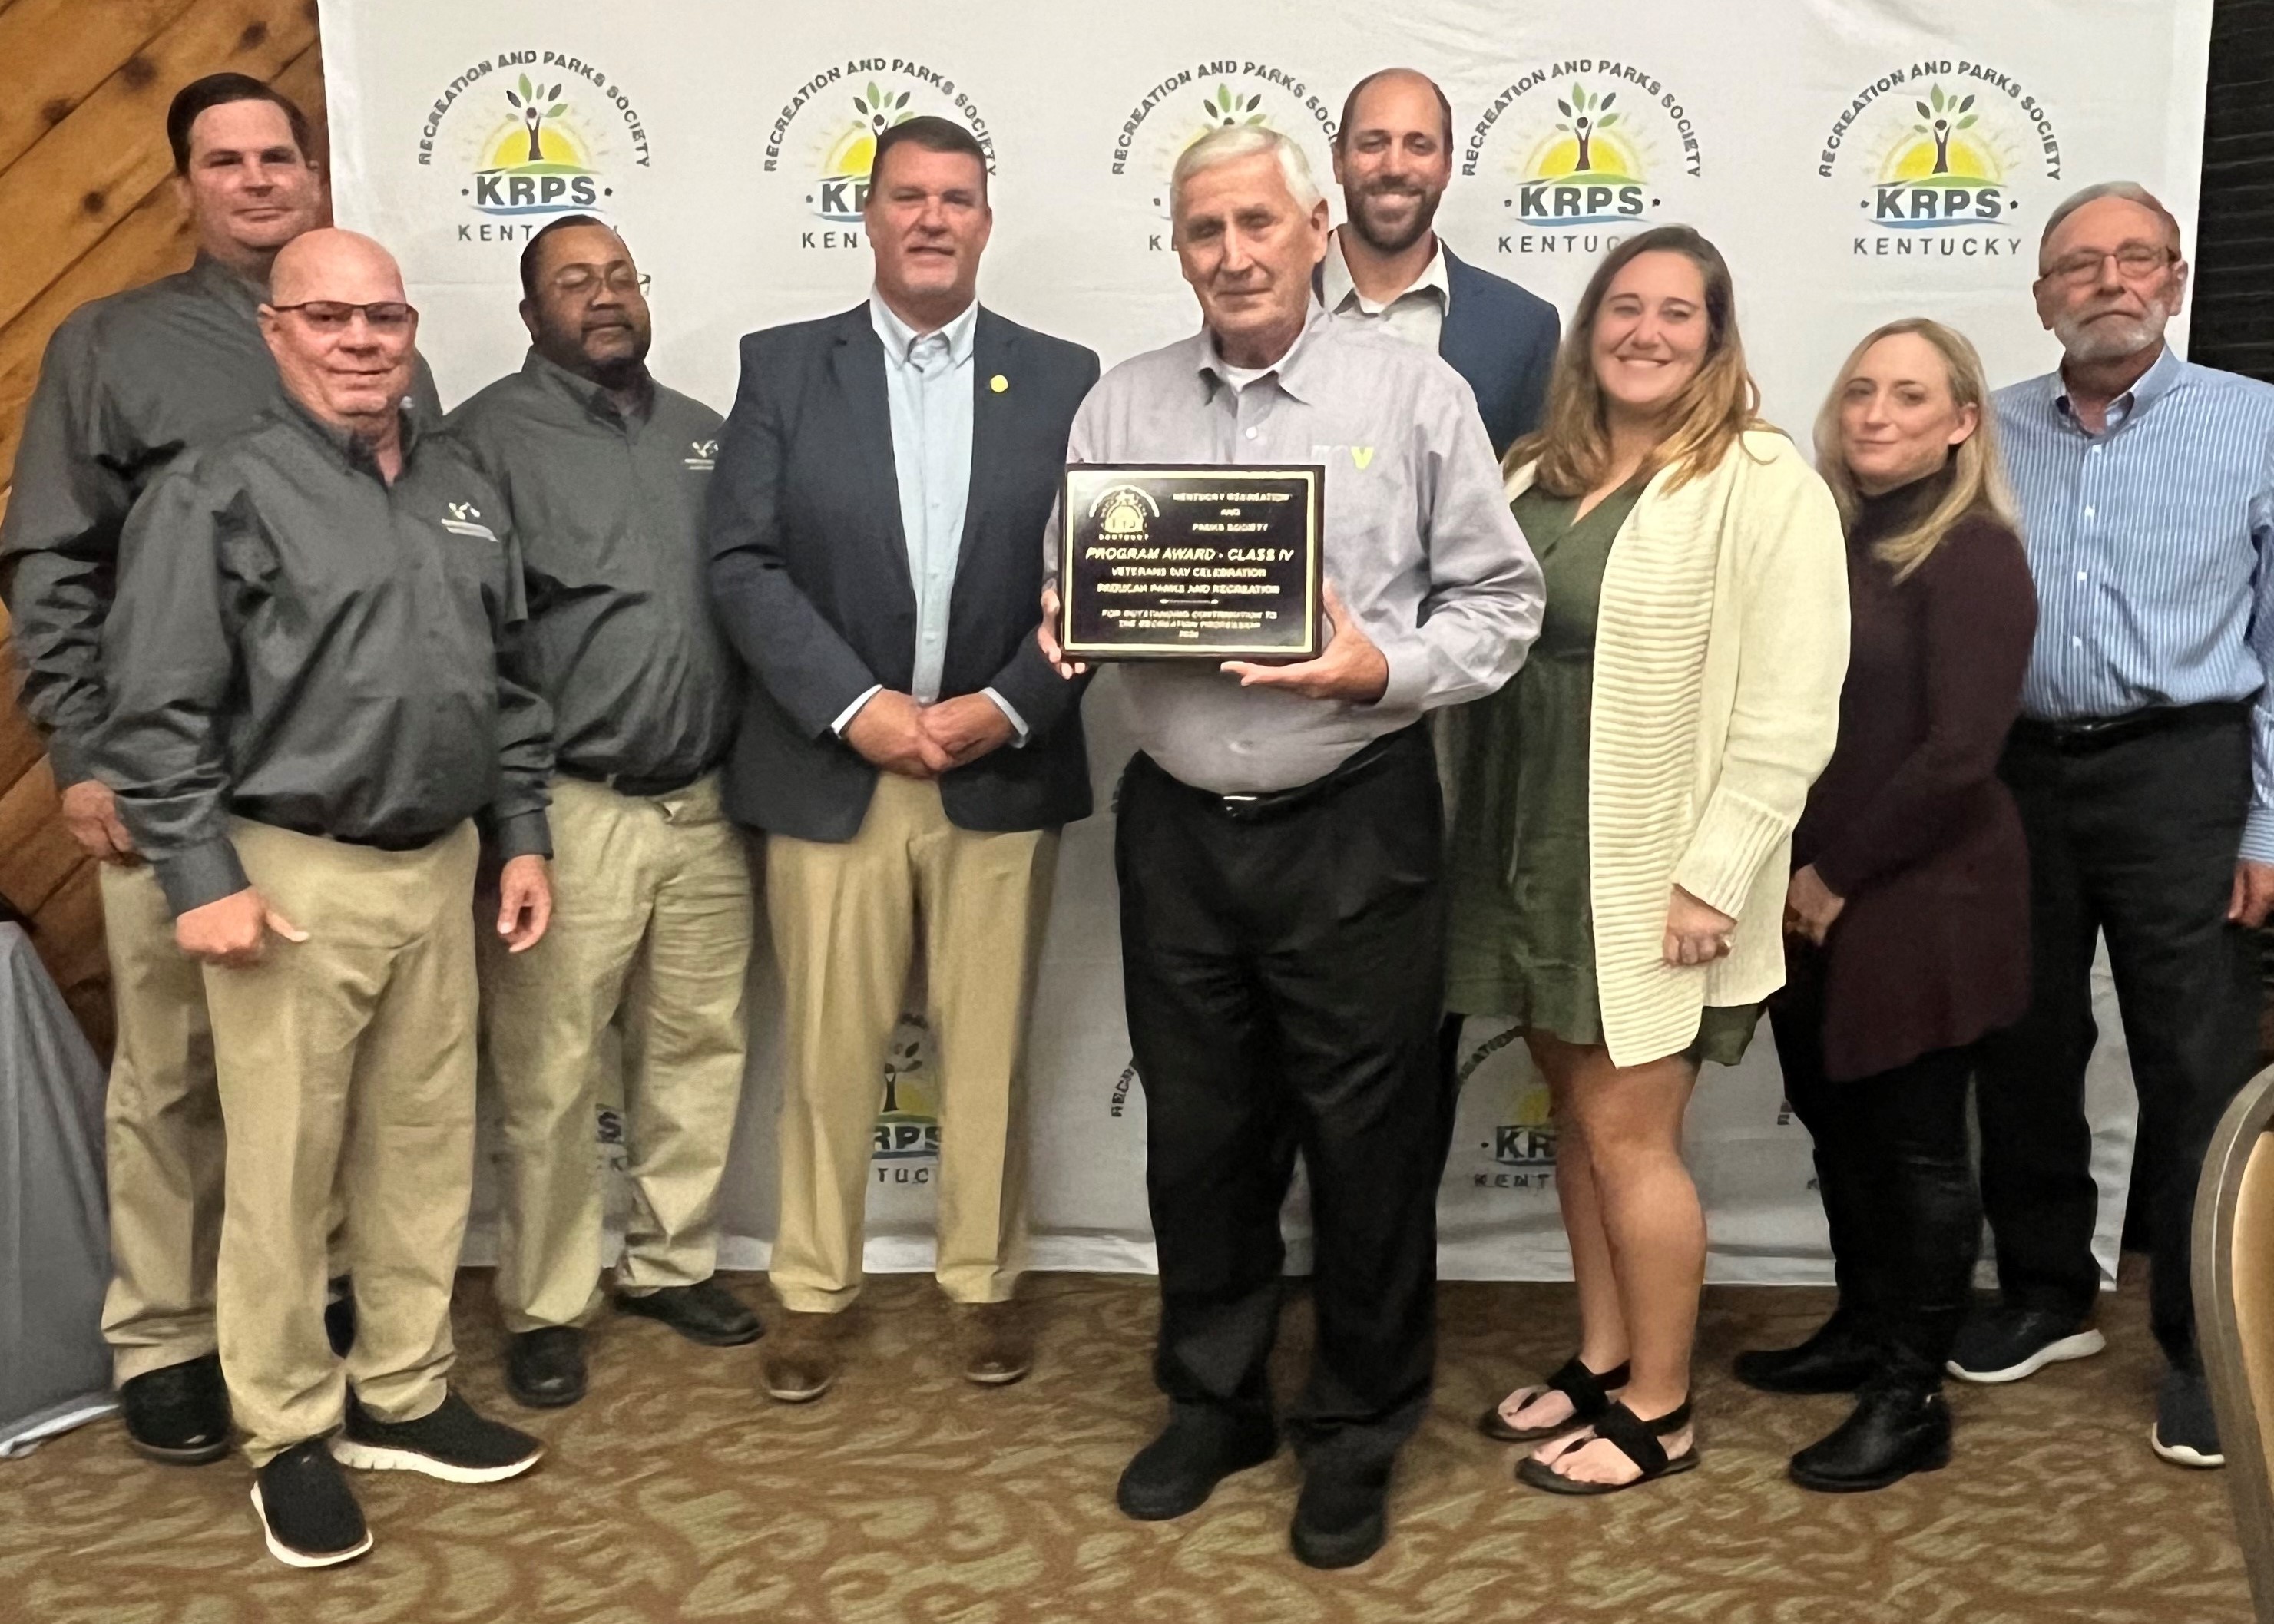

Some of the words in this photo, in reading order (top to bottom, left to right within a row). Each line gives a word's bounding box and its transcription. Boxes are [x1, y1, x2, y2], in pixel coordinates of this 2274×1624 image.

[419, 60, 493, 166] RECREATION
[498, 50, 538, 69] AND
[543, 51, 606, 88] PARKS
[606, 85, 650, 168] SOCIETY
[763, 67, 842, 172] RECREATION
[846, 58, 887, 75] AND
[892, 58, 955, 96] PARKS
[1111, 70, 1192, 175] RECREATION
[1197, 60, 1238, 79] AND
[1243, 61, 1306, 98] PARKS
[1462, 69, 1546, 177] RECREATION
[1551, 59, 1592, 79] AND
[1598, 59, 1661, 96] PARKS
[1661, 93, 1701, 178] SOCIETY
[1818, 68, 1905, 177] RECREATION
[1910, 60, 1952, 81] AND
[1958, 61, 2022, 98] PARKS
[2020, 95, 2061, 180] SOCIETY
[476, 176, 597, 206] KRPS
[1521, 186, 1643, 217] KRPS
[1876, 188, 2001, 220] KRPS
[1498, 235, 1620, 253] KENTUC
[1852, 237, 2021, 256] KENTUCKY
[1085, 547, 1160, 560] PROGRAM
[1162, 547, 1216, 561] AWARD
[1227, 548, 1275, 561] CLASS
[1279, 549, 1294, 561] IV
[1496, 1126, 1557, 1158] KR
